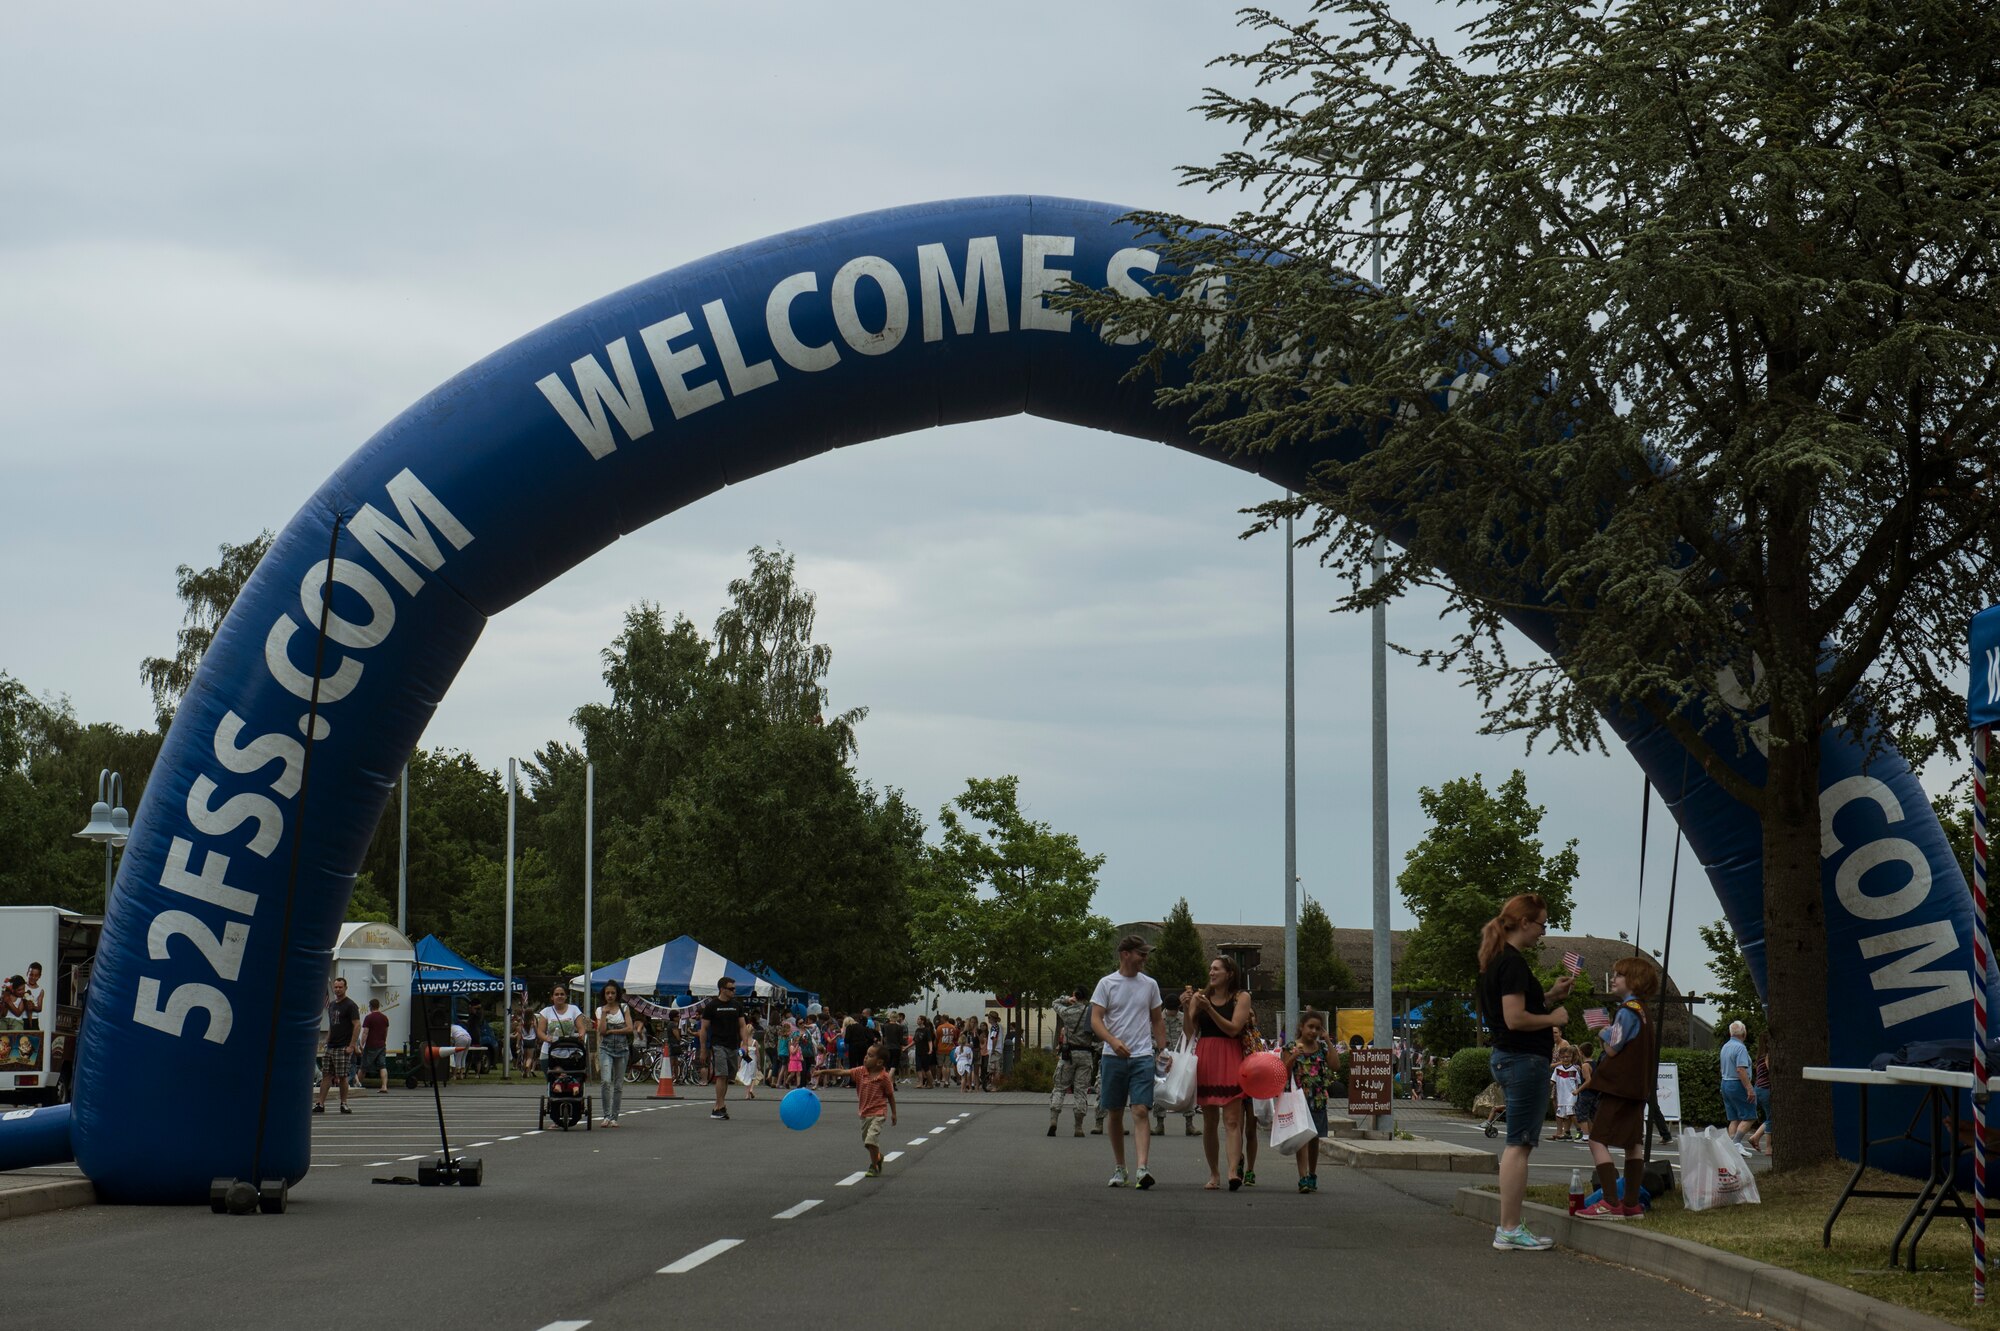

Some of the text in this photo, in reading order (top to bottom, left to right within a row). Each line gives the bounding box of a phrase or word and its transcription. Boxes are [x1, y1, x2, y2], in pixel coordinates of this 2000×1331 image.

[535, 234, 1076, 461] WELCOME
[132, 467, 475, 1045] 52FSS.COM
[1352, 1052, 1390, 1064] This Parking
[1350, 1065, 1391, 1075] will be closed
[1355, 1080, 1360, 1088] 3
[1364, 1080, 1369, 1088] 4
[1370, 1080, 1385, 1091] July
[1361, 1091, 1370, 1099] For
[1349, 1102, 1391, 1112] upcoming Event!
